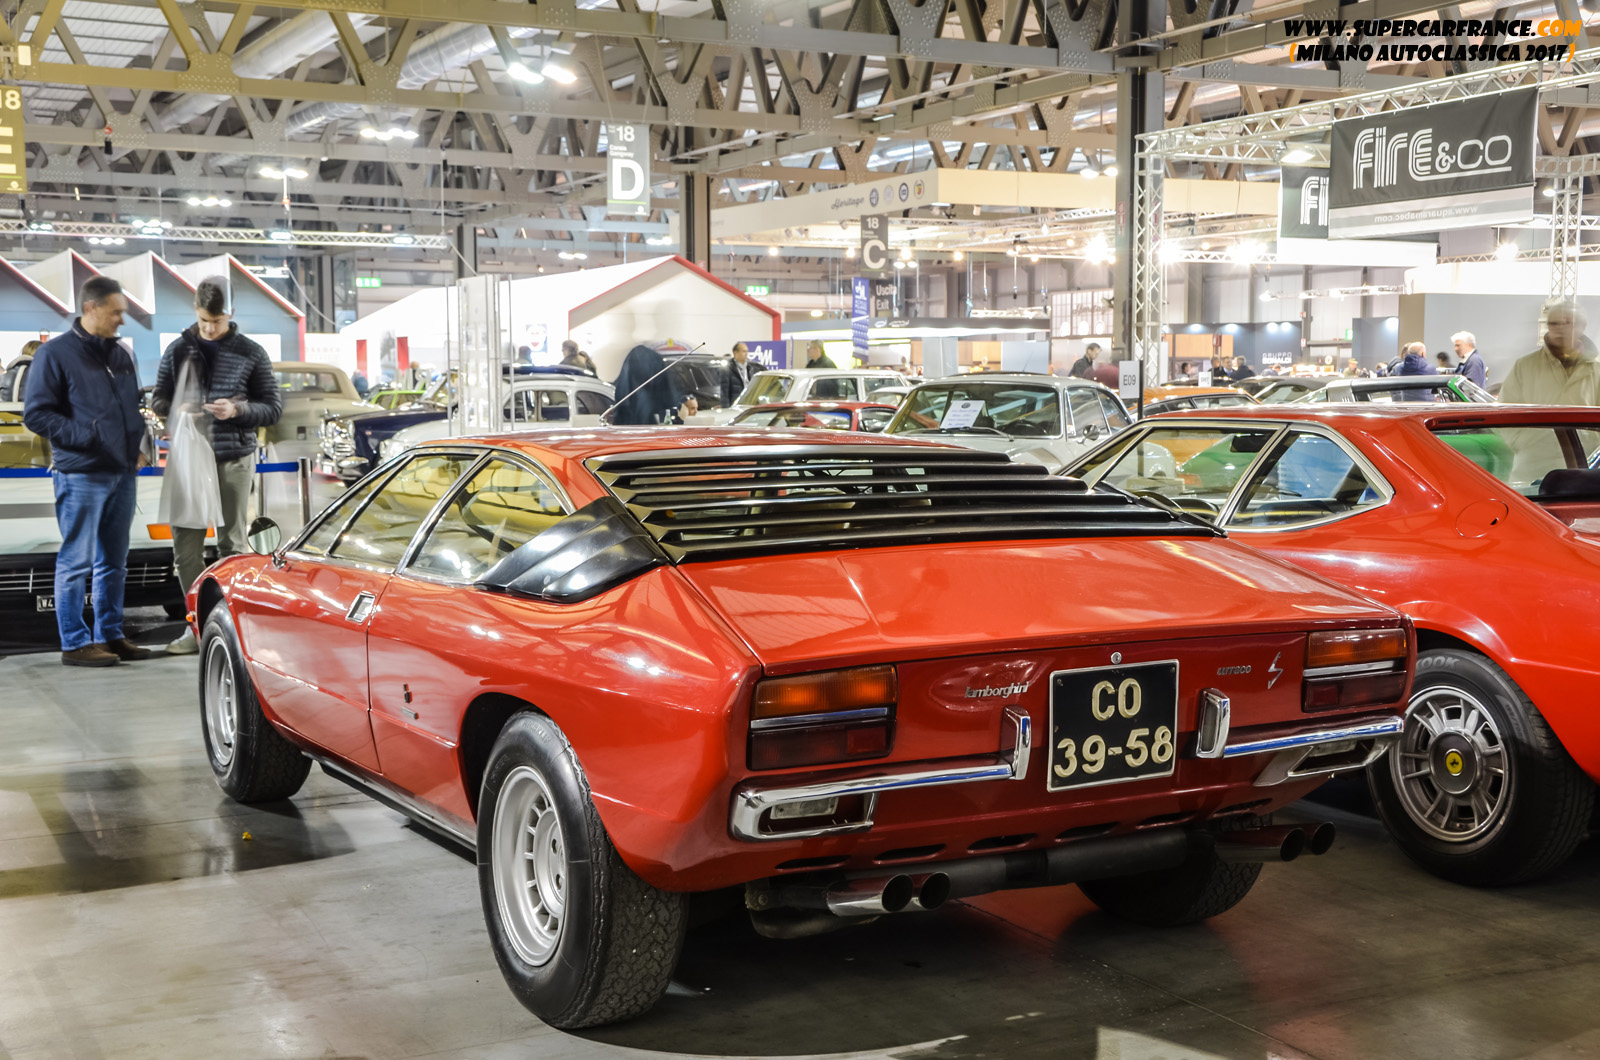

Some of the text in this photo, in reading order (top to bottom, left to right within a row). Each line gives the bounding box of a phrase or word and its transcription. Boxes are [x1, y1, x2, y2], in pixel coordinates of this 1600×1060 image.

[616, 125, 635, 142] 18
[612, 159, 645, 200] D
[831, 197, 865, 210] Heritage
[866, 217, 879, 229] 18
[863, 239, 886, 269] C
[876, 298, 889, 310] Exit
[1123, 375, 1136, 386] E09
[1416, 656, 1460, 671] OOK
[1091, 678, 1142, 721] CO
[1053, 725, 1174, 778] 39-58
